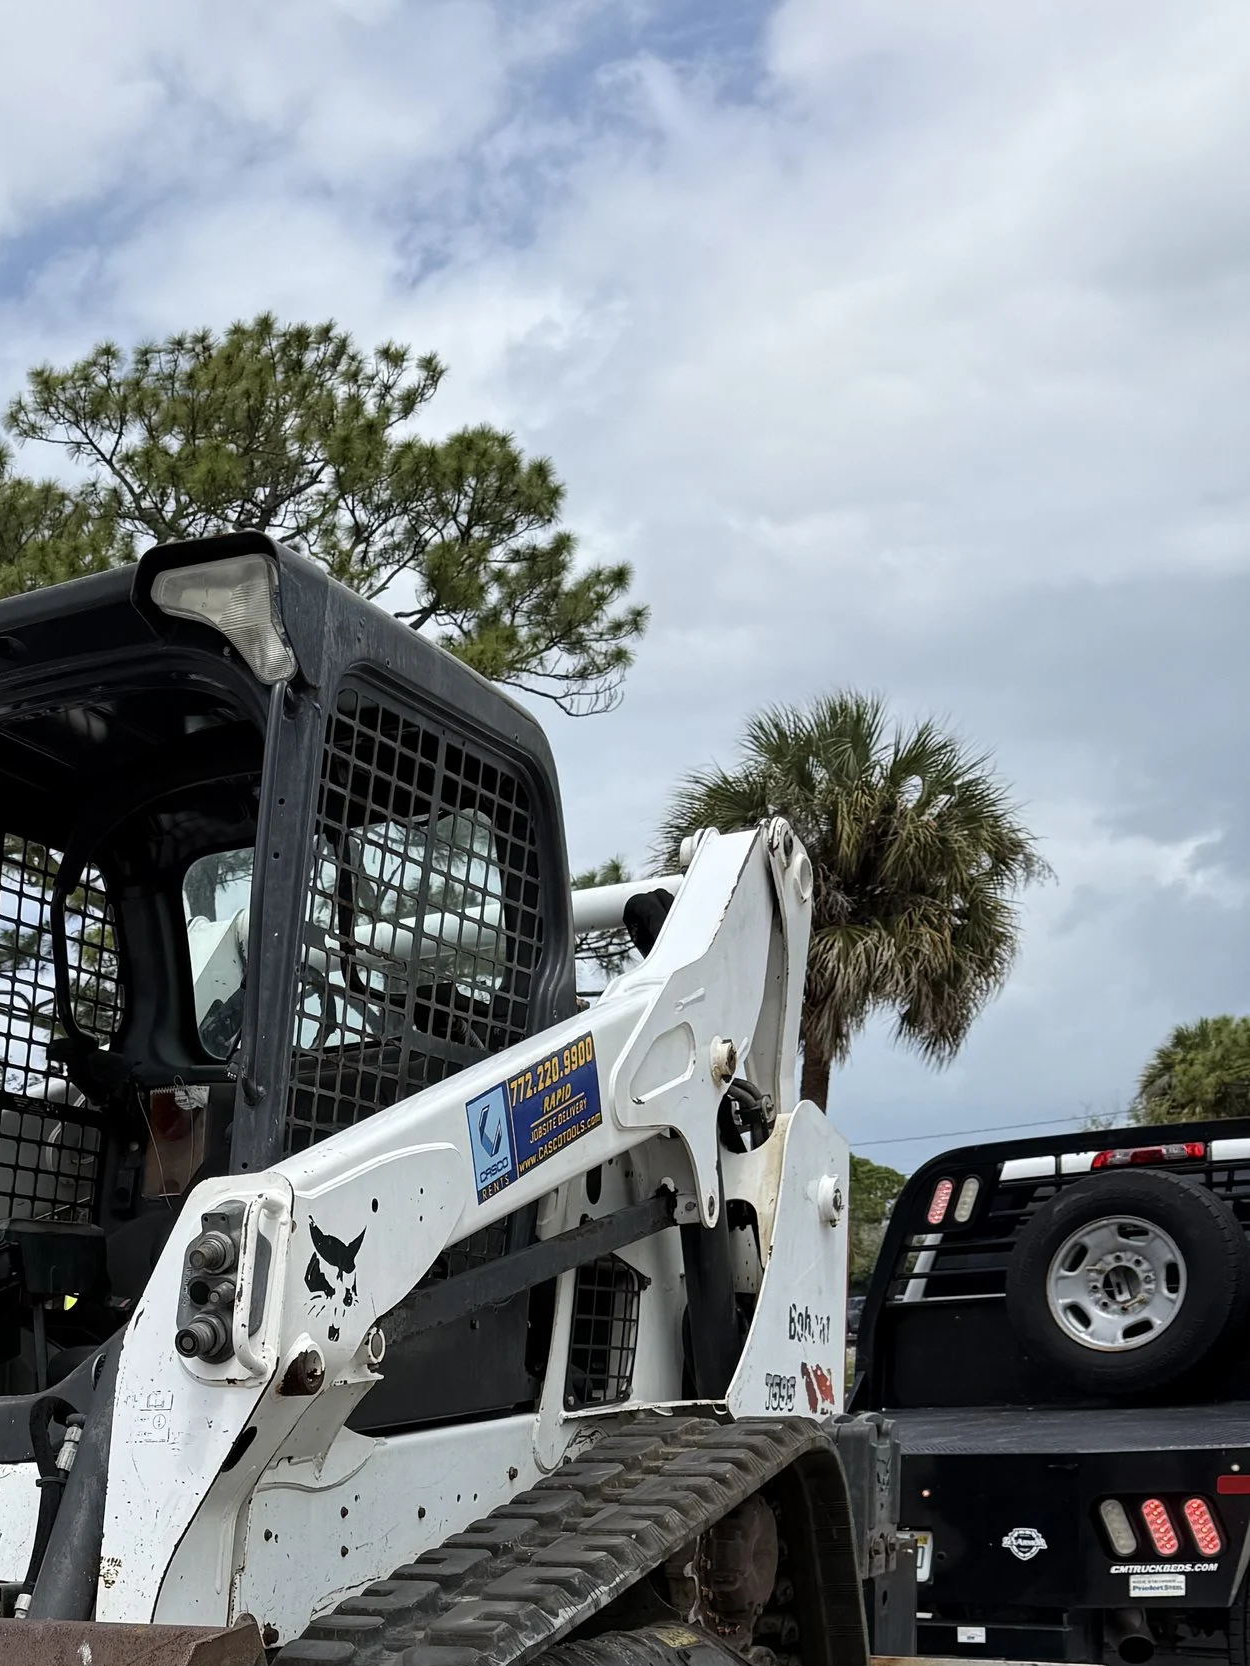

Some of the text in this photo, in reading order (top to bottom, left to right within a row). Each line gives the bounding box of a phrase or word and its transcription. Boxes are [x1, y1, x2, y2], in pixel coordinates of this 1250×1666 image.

[509, 1036, 593, 1107] 772.220.9900
[542, 1083, 572, 1114] RAPID
[529, 1097, 587, 1144] JOBSITE DELIVERY
[518, 1112, 601, 1172] www.CASCOTOOLS.com
[479, 1156, 509, 1184] CASCO
[481, 1175, 510, 1200] RENTS
[765, 1372, 796, 1413] T595
[1110, 1563, 1219, 1574] CMTRUCKBEDS.COM
